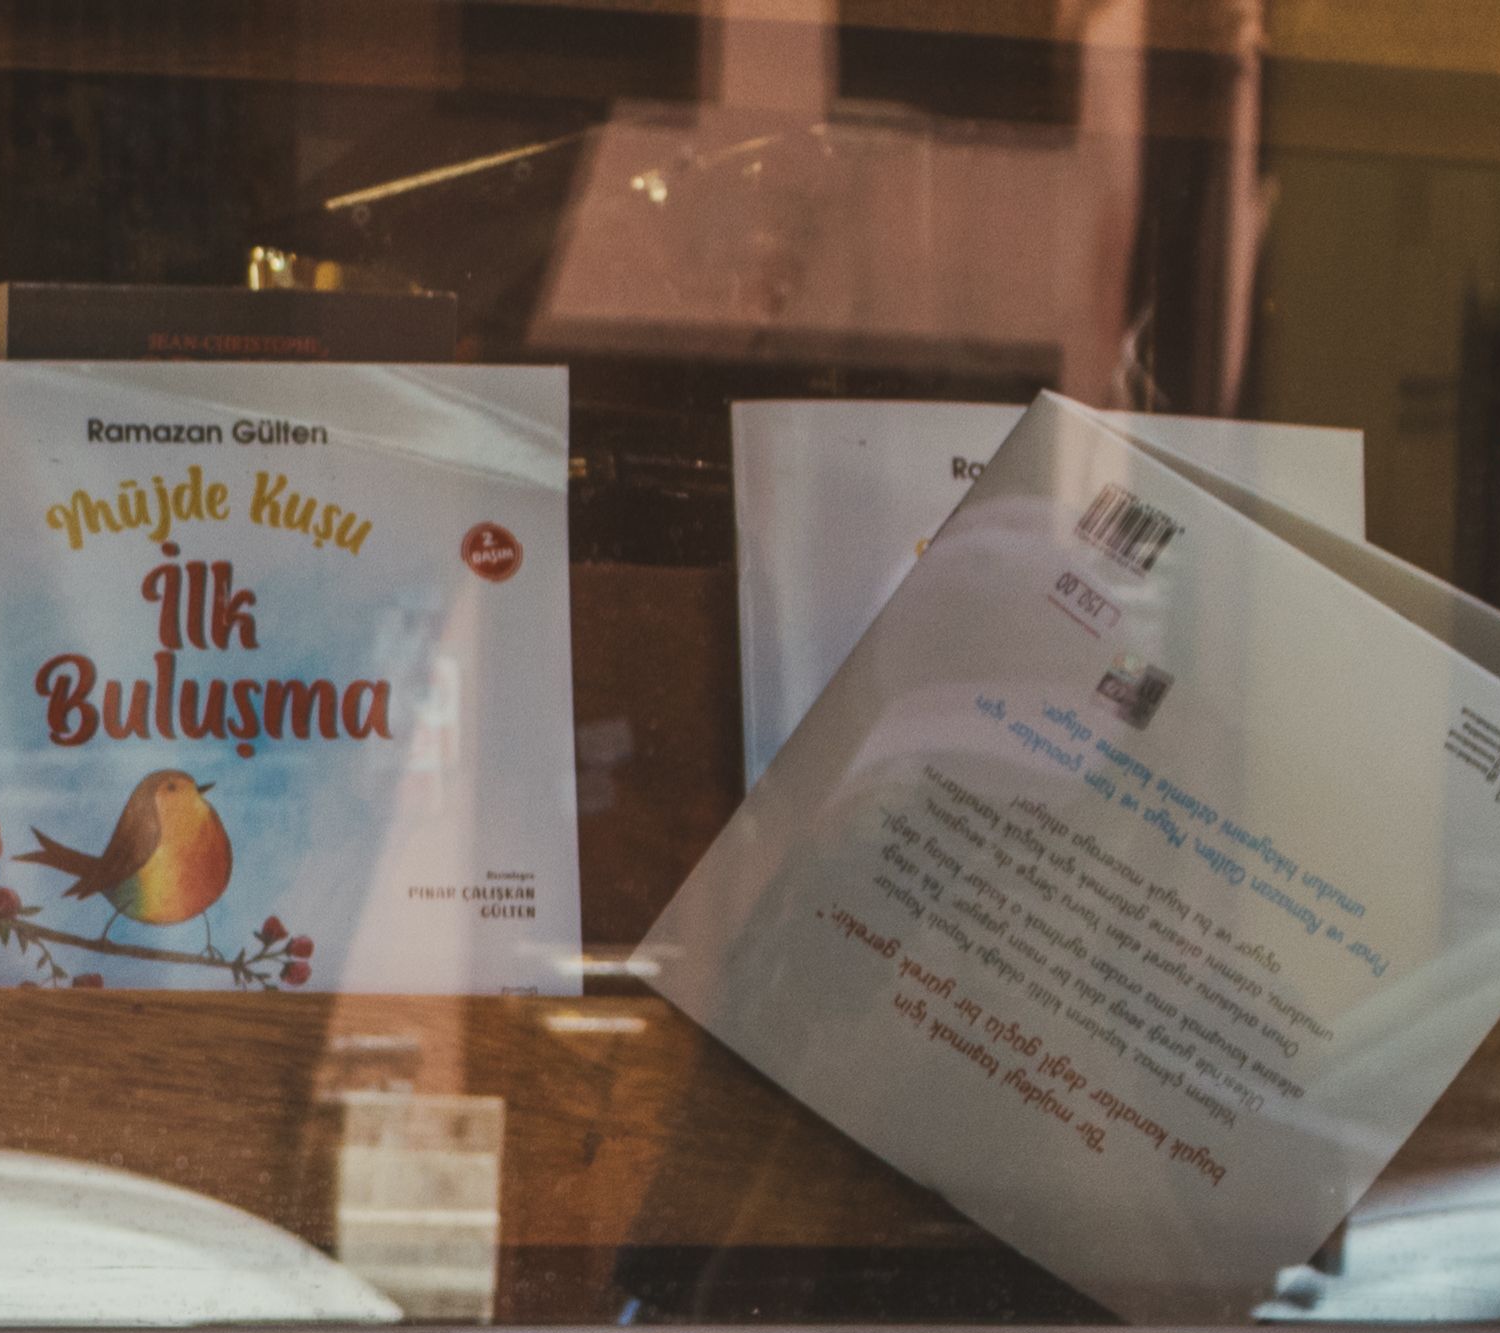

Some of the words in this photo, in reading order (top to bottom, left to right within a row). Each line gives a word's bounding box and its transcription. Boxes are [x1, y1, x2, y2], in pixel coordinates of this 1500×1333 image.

[87, 418, 223, 444] Ramazan
[232, 418, 328, 446] Gülten
[46, 464, 231, 551] Müjde
[250, 470, 373, 556] Kuşu
[140, 541, 259, 650] İlk
[35, 650, 393, 759] Buluşma
[1139, 804, 1190, 849] Maya
[920, 836, 965, 878] kolay
[1070, 830, 1146, 888] maceraya
[918, 872, 946, 902] Tek
[960, 870, 1008, 910] kadar
[1144, 878, 1193, 920] büyük
[1246, 875, 1324, 936] Ramazan
[1298, 869, 1367, 922] umudun
[1057, 892, 1102, 931] Yavru
[1006, 934, 1048, 967] insan
[1102, 922, 1142, 954] eden
[896, 952, 958, 1002] yürek
[972, 942, 1027, 986] olduğu
[1046, 962, 1072, 987] bir
[1088, 954, 1143, 998] oradan
[889, 988, 930, 1028] için
[950, 994, 983, 1026] bir
[1070, 977, 1106, 1008] dolu
[1143, 990, 1178, 1018] ama
[1192, 980, 1260, 1030] avlusunu
[982, 1012, 1044, 1060] güçlü
[1257, 1022, 1300, 1060] Onun
[1036, 1048, 1090, 1096] değil
[1086, 1086, 1170, 1150] kanatlar
[1166, 1134, 1229, 1188] büyük
